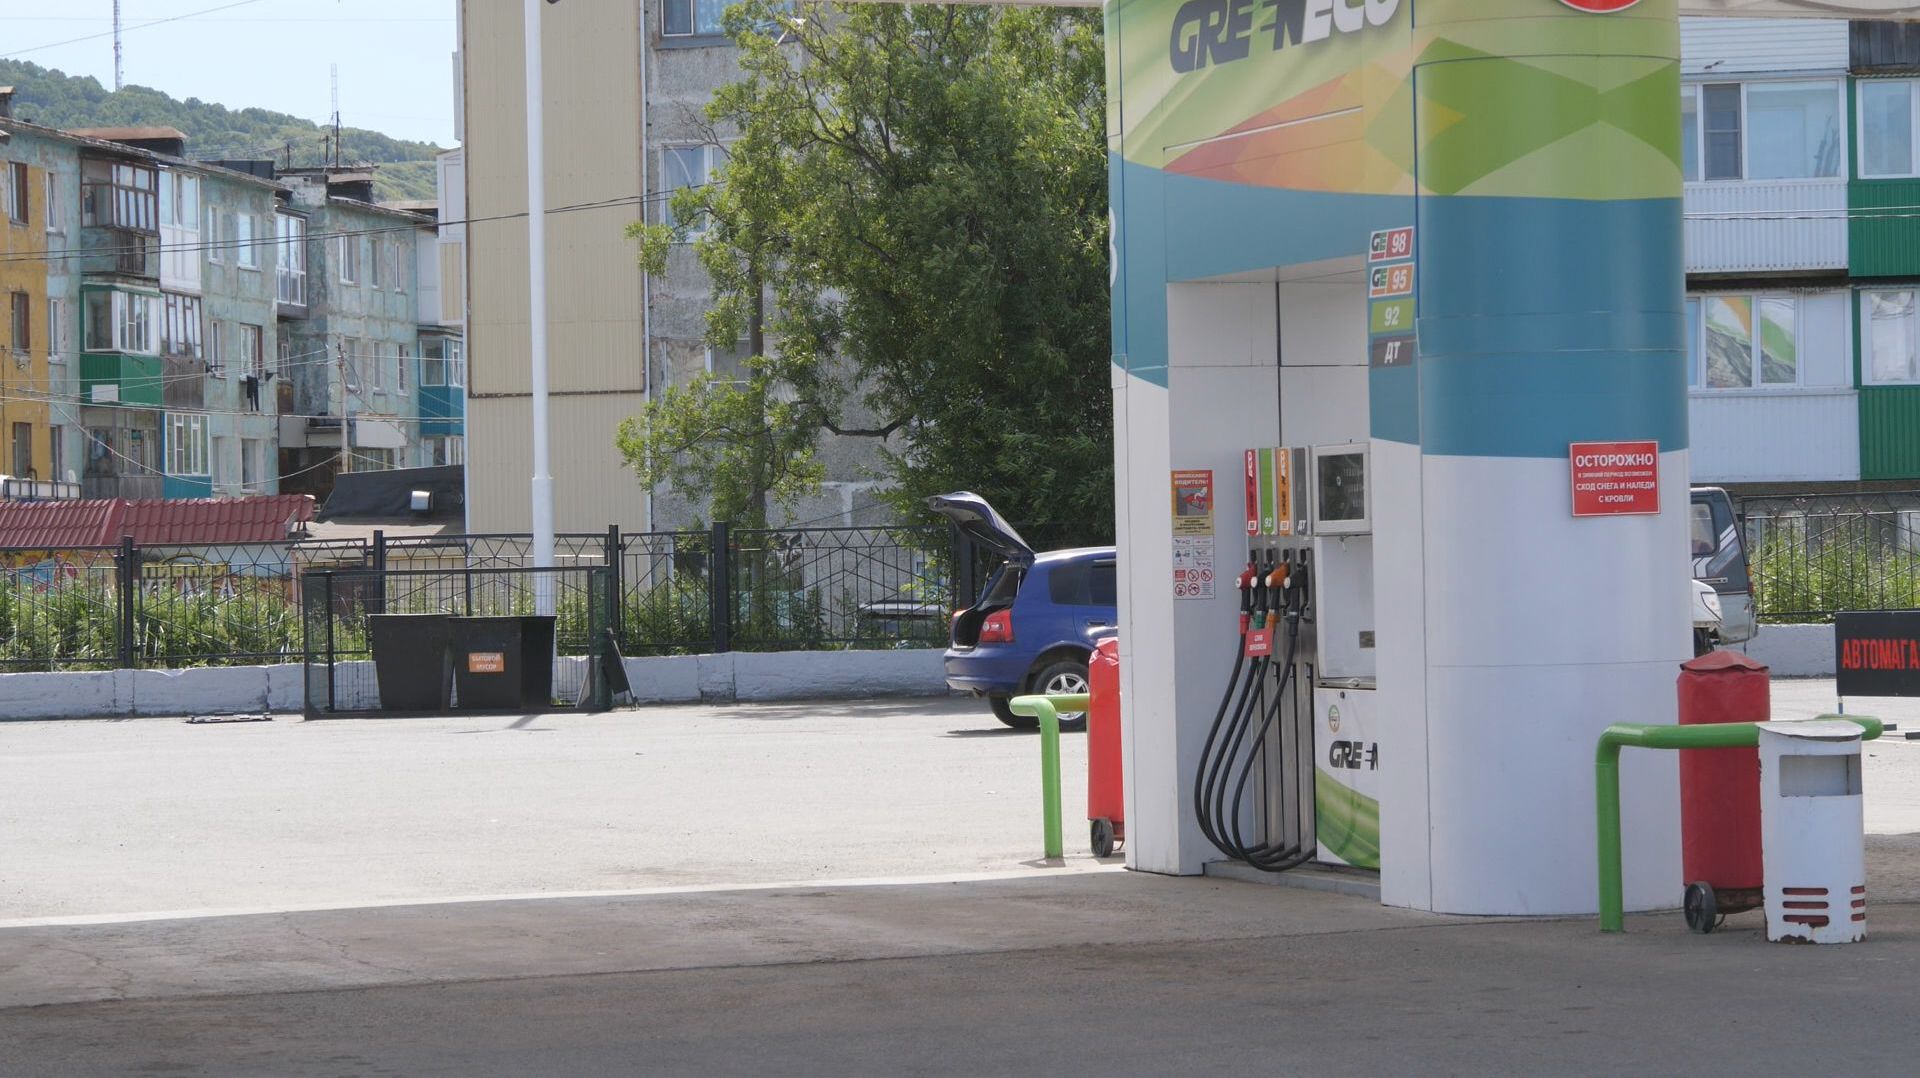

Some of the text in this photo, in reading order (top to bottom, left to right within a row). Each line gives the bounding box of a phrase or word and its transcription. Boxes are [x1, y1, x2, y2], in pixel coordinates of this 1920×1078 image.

[1391, 232, 1406, 254] 98
[1392, 268, 1408, 290] 95
[1384, 306, 1400, 327] 92
[1384, 341, 1401, 364] ДТ
[1575, 453, 1655, 468] ОСТОРОЖНО
[1576, 483, 1596, 491] СХОД
[1597, 482, 1619, 490] СНЕГА
[1627, 481, 1655, 490] НАЛЕДИ
[1599, 494, 1634, 503] С КРОВЛИ
[1842, 639, 1920, 670] АВТОМАГА
